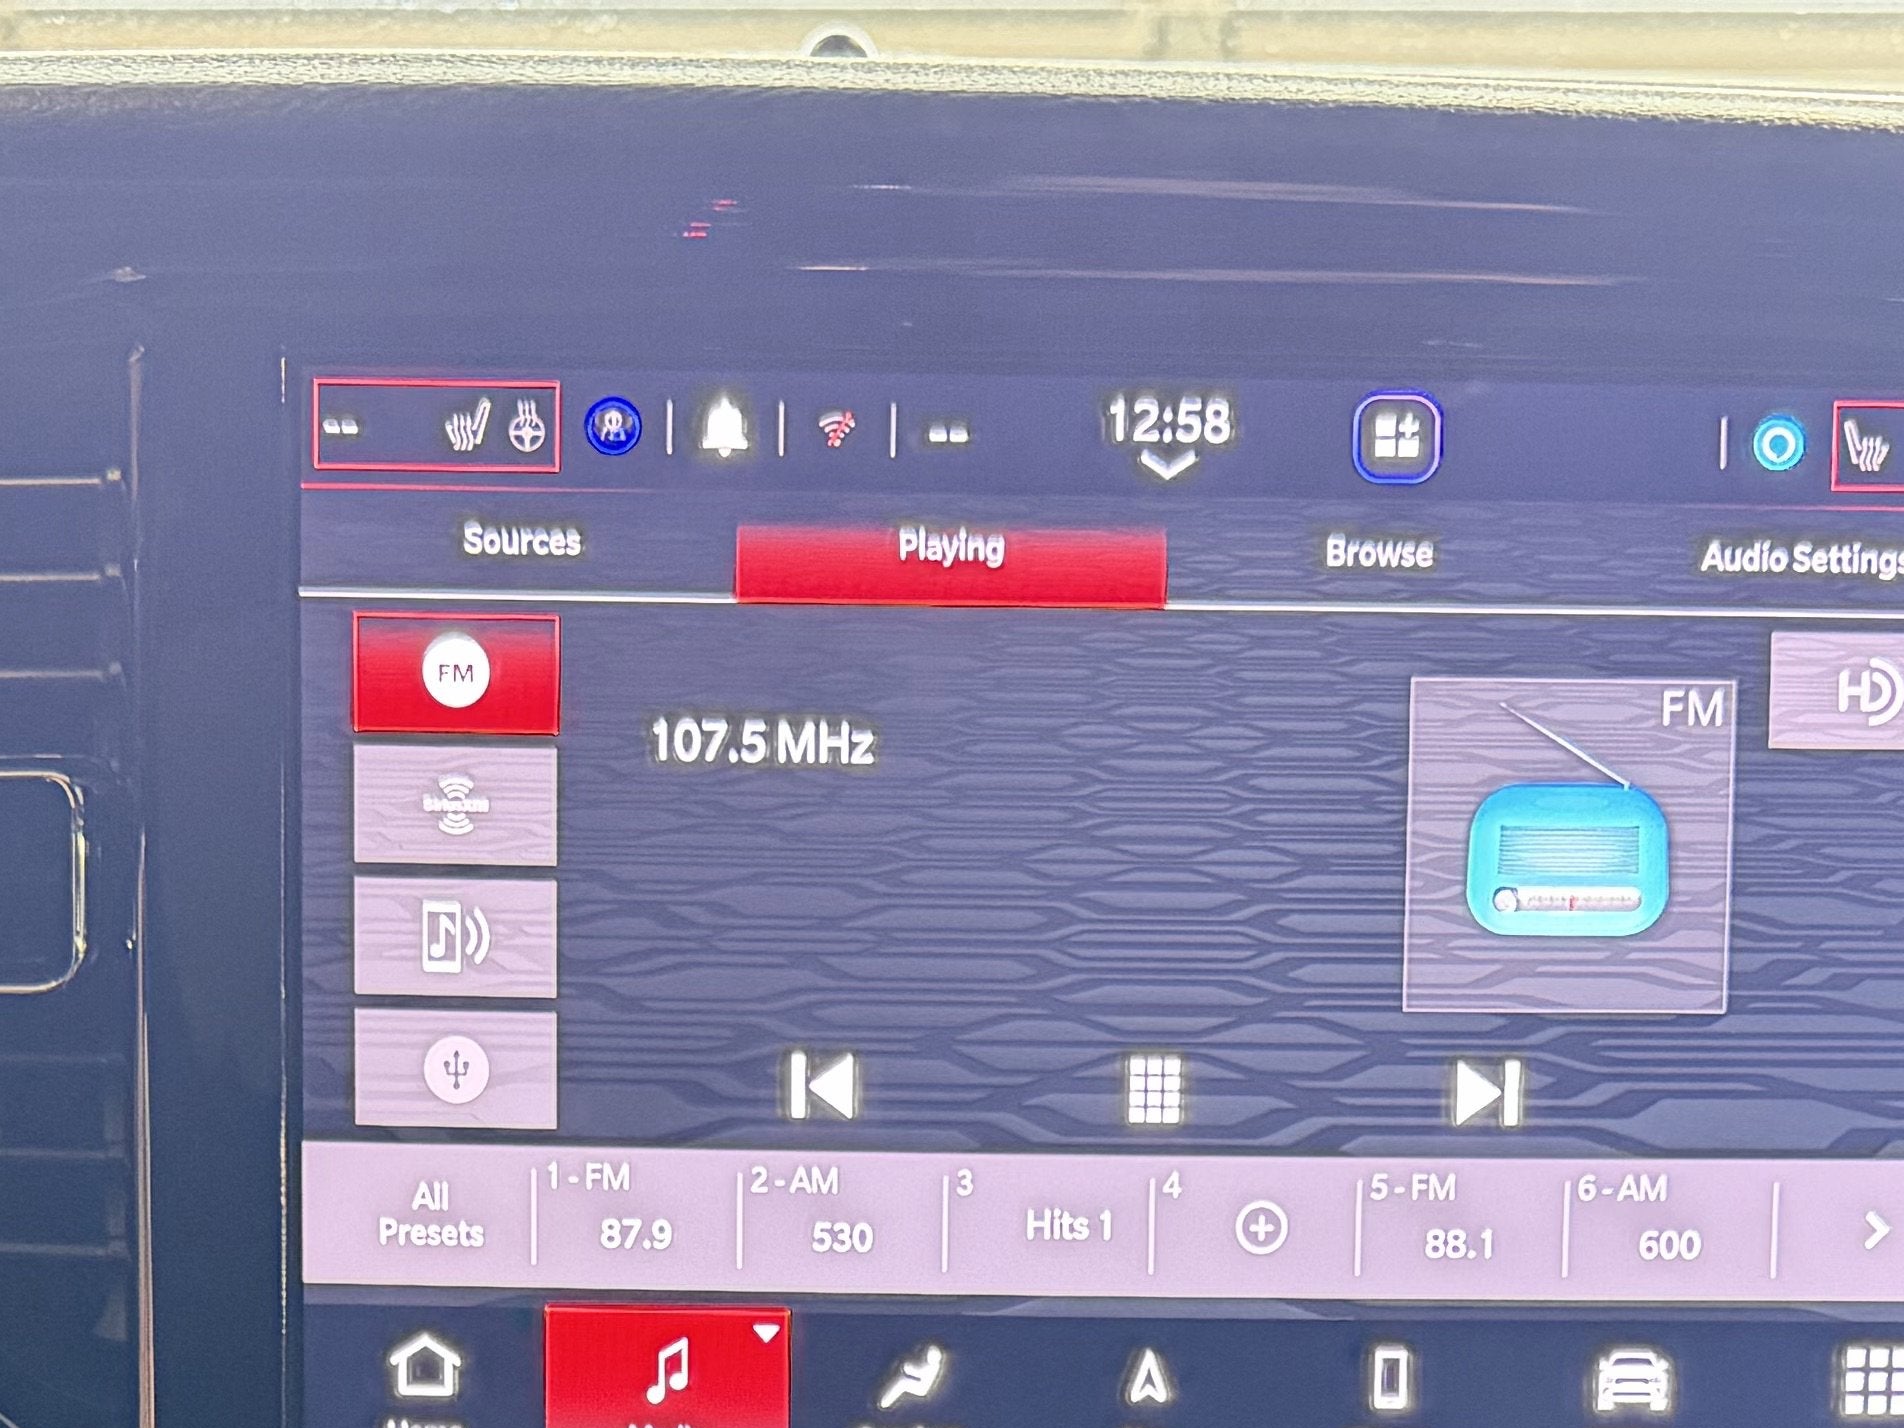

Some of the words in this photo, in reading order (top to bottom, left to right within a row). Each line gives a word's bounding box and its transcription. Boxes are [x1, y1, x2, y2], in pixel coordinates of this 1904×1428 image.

[1109, 393, 1231, 444] 12:58
[463, 522, 582, 556] Sources
[898, 525, 1005, 567] Playing
[1326, 534, 1435, 569] Browse
[1701, 540, 1789, 574] Audio
[437, 661, 475, 685] FM
[1663, 688, 1724, 728] FM
[652, 719, 767, 764] 107.5
[776, 722, 876, 767] MHz
[411, 1181, 449, 1212] All
[956, 1170, 974, 1197] 3
[1162, 1172, 1183, 1200] 4
[378, 1219, 486, 1249] Presets
[599, 1218, 674, 1251] 87.9
[811, 1222, 874, 1254] 530
[1026, 1209, 1091, 1241] Hits
[1099, 1212, 1114, 1241] 1
[1424, 1228, 1494, 1261] 88.1
[1637, 1229, 1702, 1262] 600
